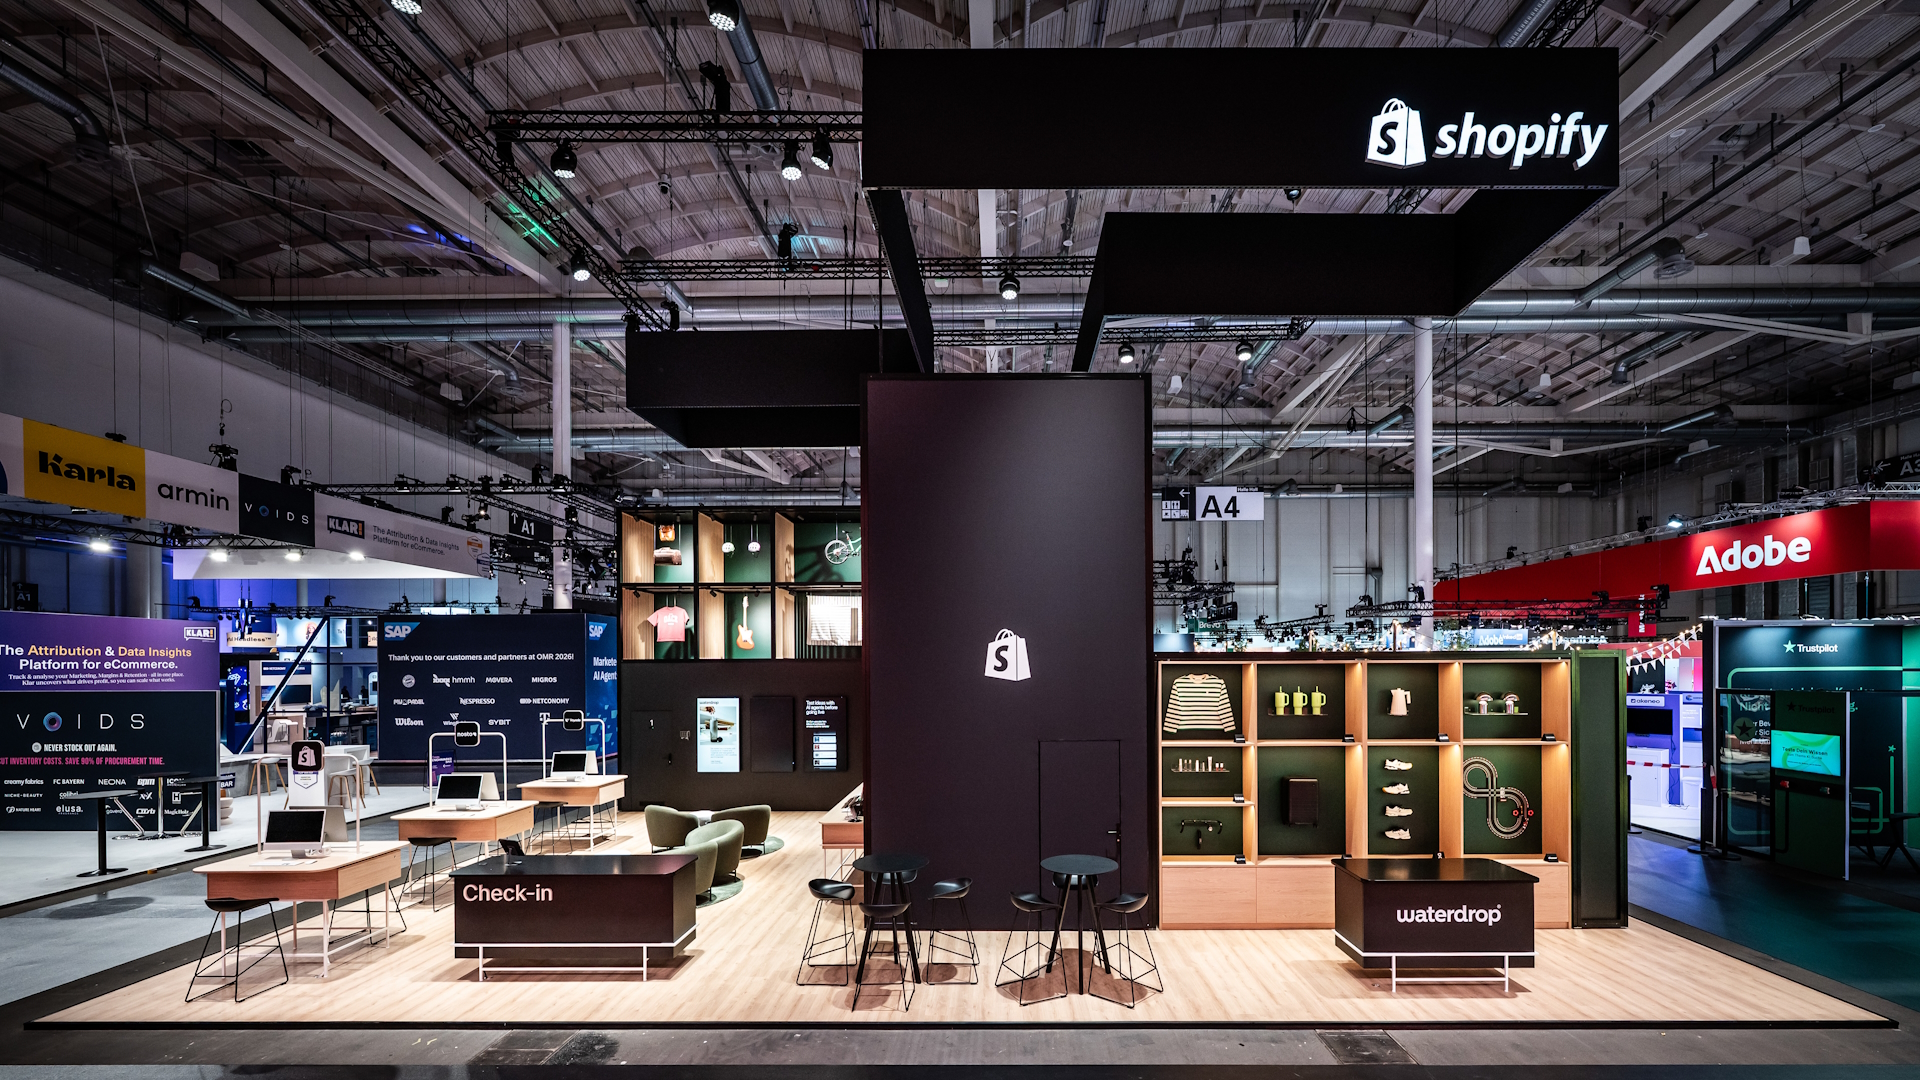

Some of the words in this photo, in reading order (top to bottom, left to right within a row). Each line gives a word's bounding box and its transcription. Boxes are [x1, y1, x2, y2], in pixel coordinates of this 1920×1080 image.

[1433, 111, 1608, 169] shopify
[38, 450, 136, 492] Karla
[157, 482, 230, 511] armin
[1201, 494, 1240, 518] A4
[244, 502, 309, 525] VOIDS
[328, 518, 364, 537] KLAR!
[521, 518, 535, 536] A1
[373, 525, 386, 536] The
[386, 528, 419, 545] Attribution
[425, 537, 439, 546] Data
[438, 541, 460, 551] Insights
[372, 534, 400, 547] Platform
[400, 541, 410, 549] for
[410, 543, 446, 556] eCommerce.
[1695, 534, 1812, 576] Adobe
[16, 592, 31, 602] A1
[186, 629, 214, 638] KLAR!
[384, 625, 412, 638] SAP
[588, 624, 604, 638] SAP
[1478, 634, 1504, 645] Adobe
[0, 644, 24, 656] The
[28, 644, 101, 656] Attribution
[104, 646, 115, 656] &
[118, 646, 146, 657] Data
[148, 647, 192, 658] Insights
[1797, 643, 1838, 654] Trustpilot
[19, 659, 79, 670] Platform
[82, 659, 101, 670] for
[103, 659, 178, 670] eCommerce.
[498, 654, 527, 662] partners
[593, 671, 600, 681] AI
[459, 697, 496, 705] NESPRESSO
[1799, 704, 1835, 714] Trustpilot
[16, 712, 145, 731] VOIDS
[394, 717, 424, 726] Wilson
[44, 744, 64, 752] NEVER
[64, 744, 83, 752] STOCK
[84, 744, 96, 752] OUT
[97, 744, 117, 752] AGAIN.
[10, 757, 42, 765] INVENTORY
[43, 757, 64, 765] COSTS.
[65, 757, 80, 765] SAVE
[81, 757, 94, 765] 90%
[95, 757, 104, 765] OF
[104, 757, 147, 765] PROCUREMENT
[149, 757, 165, 765] TIME.
[98, 778, 127, 786] NEONA
[220, 780, 233, 788] BAR
[463, 883, 554, 902] Check-in
